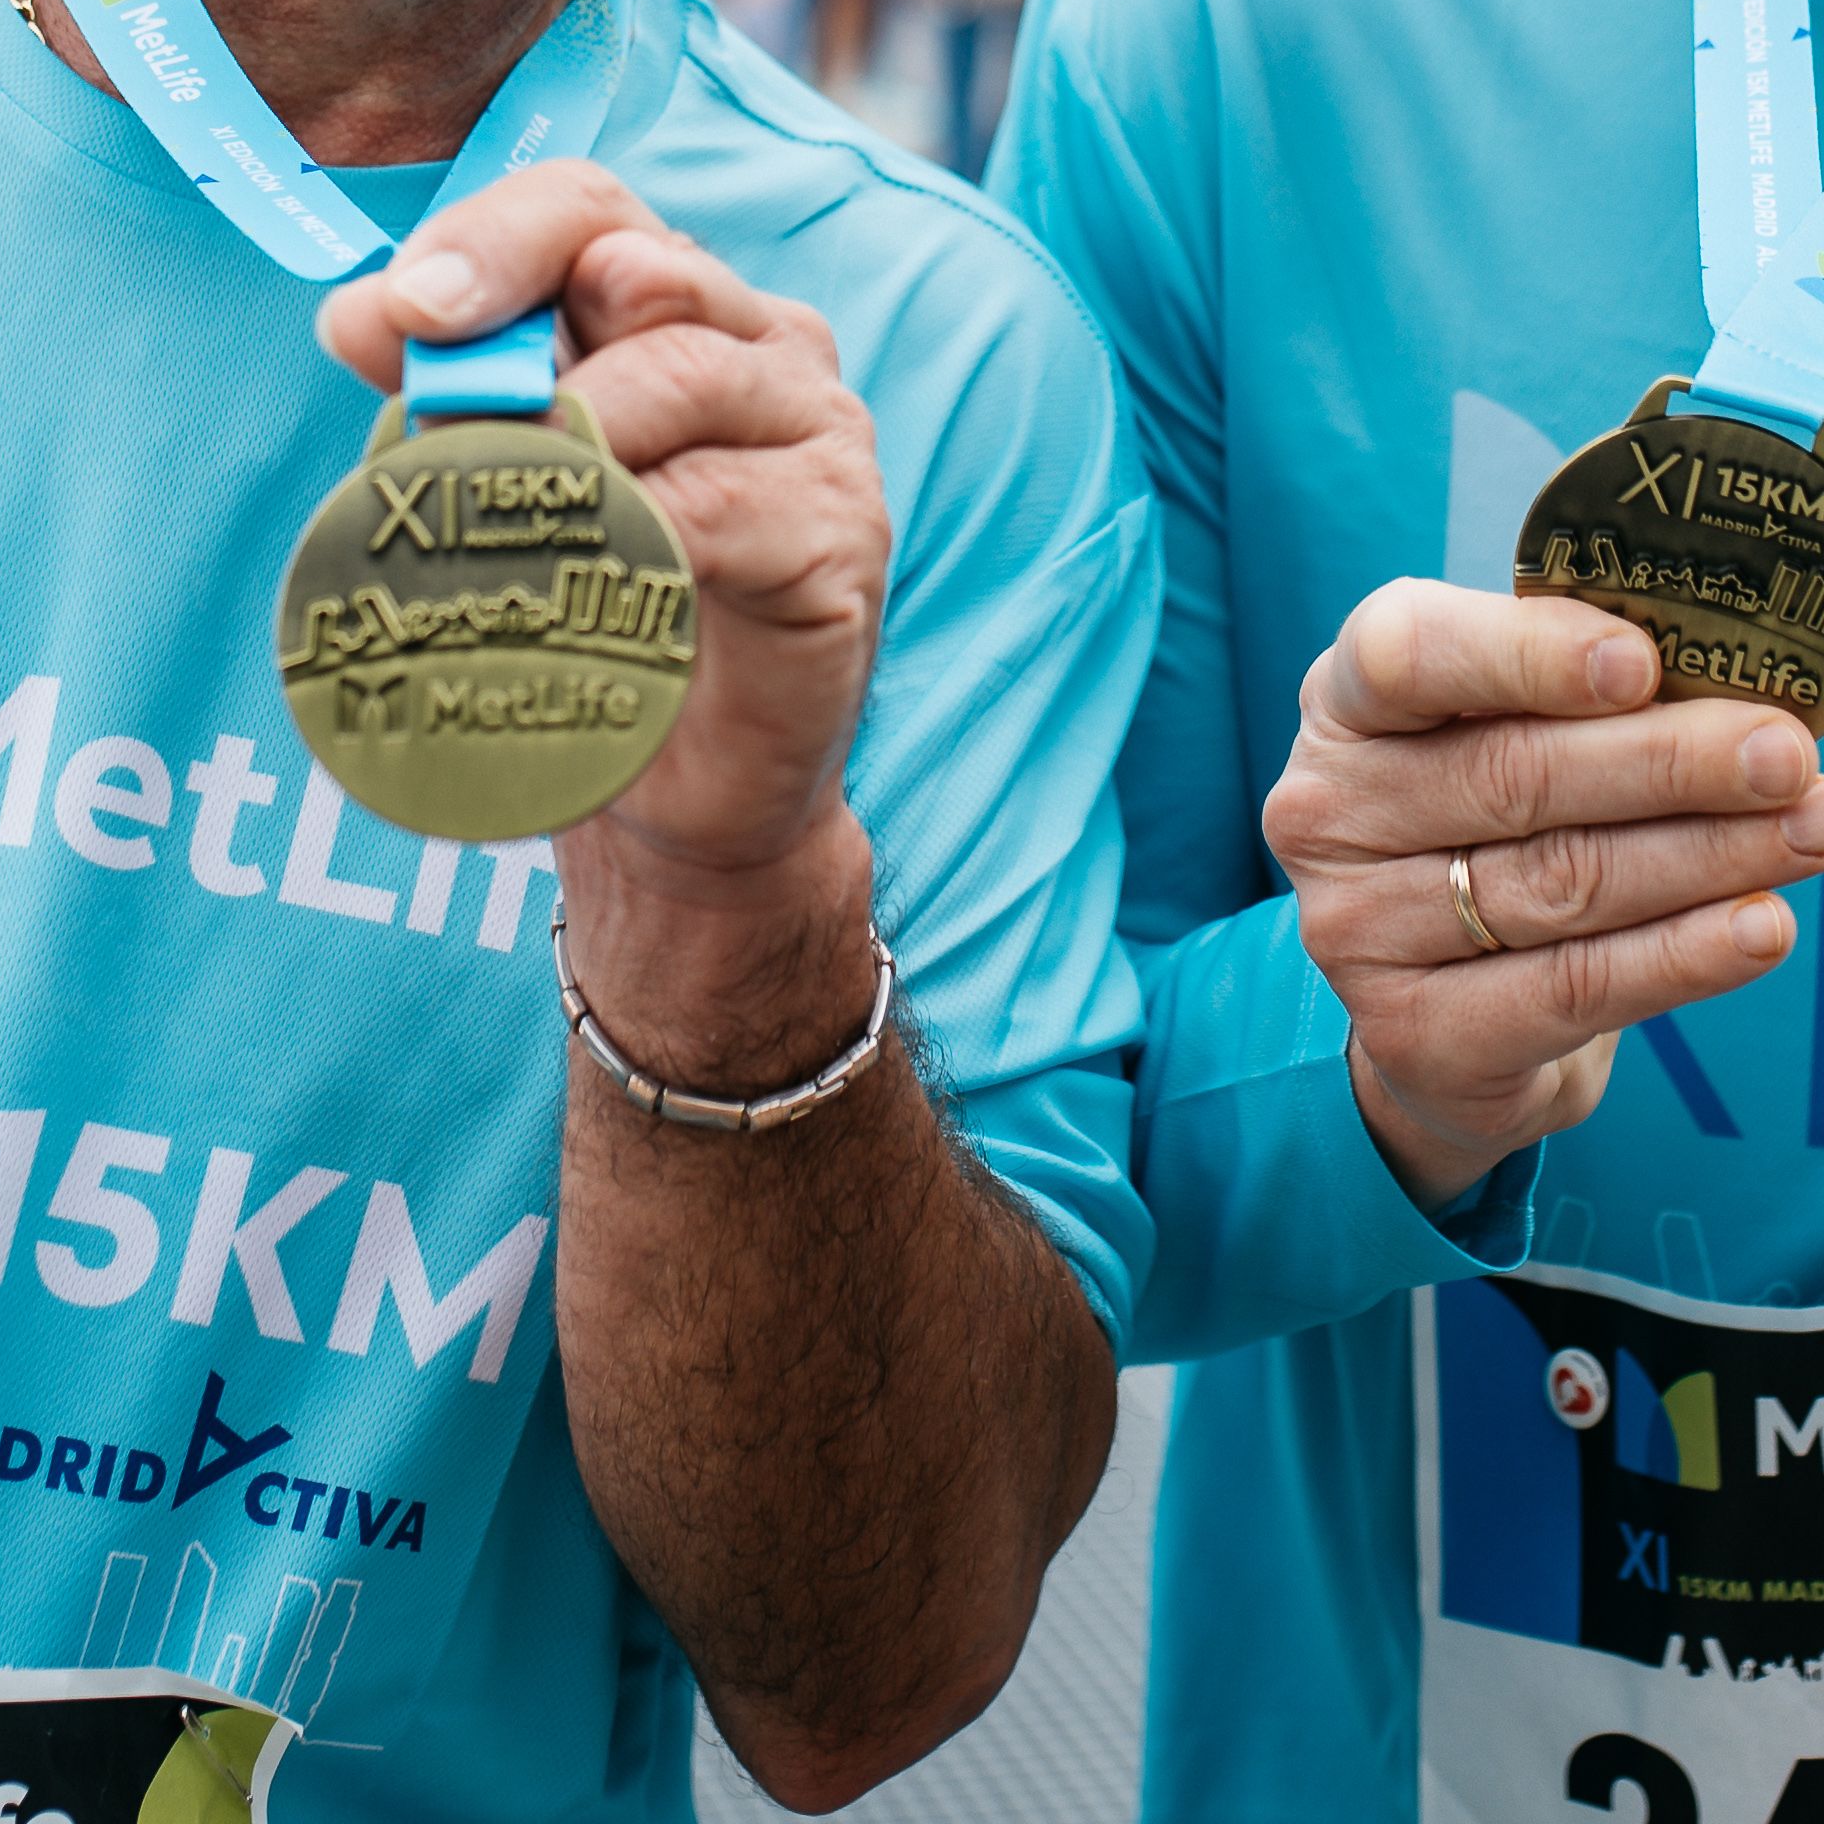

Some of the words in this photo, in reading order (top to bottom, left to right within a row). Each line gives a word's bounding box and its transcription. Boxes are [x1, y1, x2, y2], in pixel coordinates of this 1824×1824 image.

[121, 3, 206, 103] MetLife
[1746, 69, 1770, 99] 15K
[1748, 99, 1774, 165] METLIFE
[273, 194, 310, 215] 15K
[1752, 173, 1778, 236] MADRID
[368, 468, 460, 552] XI
[469, 465, 602, 512] 15KM
[1617, 441, 1703, 520] XI
[1700, 513, 1761, 538] MADRID
[1649, 624, 1819, 705] MetLife
[426, 676, 640, 733] MetLife
[1618, 1522, 1669, 1592] XI
[1678, 1575, 1753, 1601] 15KM
